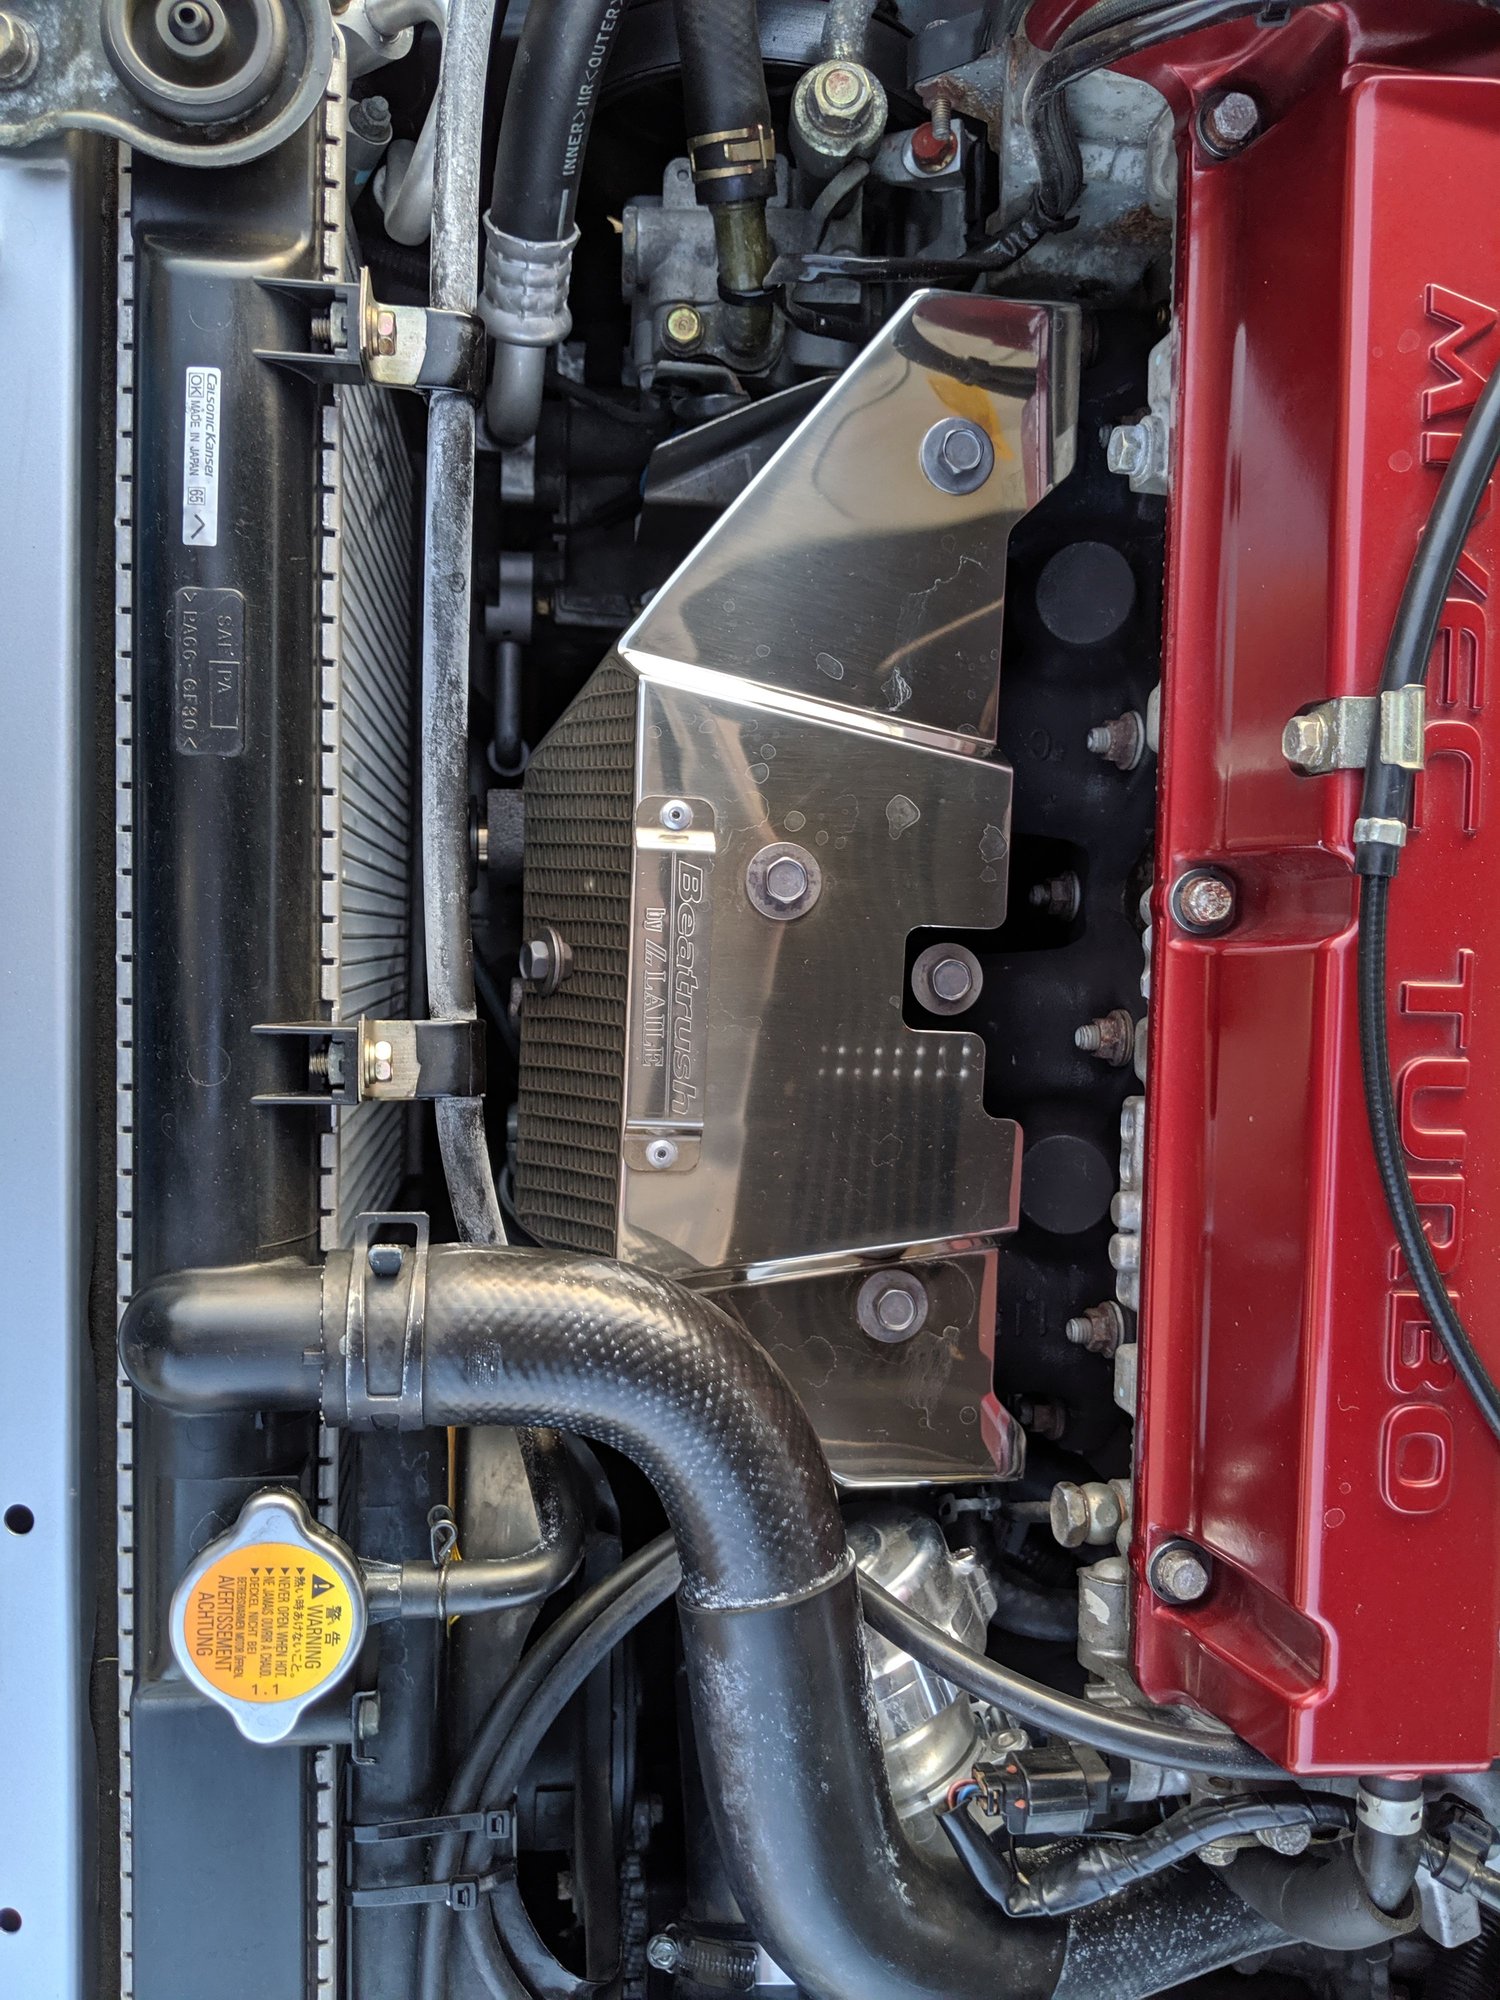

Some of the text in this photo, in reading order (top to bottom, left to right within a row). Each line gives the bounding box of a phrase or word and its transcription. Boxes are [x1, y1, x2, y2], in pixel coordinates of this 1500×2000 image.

[189, 375, 204, 503] OK MADE IN JAPAN 65
[642, 907, 666, 1067] by LAILE
[671, 860, 703, 1115] Beatrush
[1382, 948, 1475, 1513] TURBO
[247, 1576, 260, 1655] DECKEL NICHT BEI
[262, 1588, 274, 1616] JAMAIS
[263, 1576, 275, 1586] NE
[197, 1592, 215, 1656] ACHTUNG
[215, 1575, 235, 1671] AVERTISSEMENT
[234, 1632, 244, 1653] MOTOR
[260, 1618, 273, 1643] OUVRIR
[275, 1576, 290, 1678] NEVER OPEN WHEN HOT.
[290, 1576, 306, 1678] 熱い時あけないこと。
[305, 1605, 323, 1669] WARNING
[324, 1605, 342, 1646] 警告
[259, 1653, 272, 1678] CHAUD.
